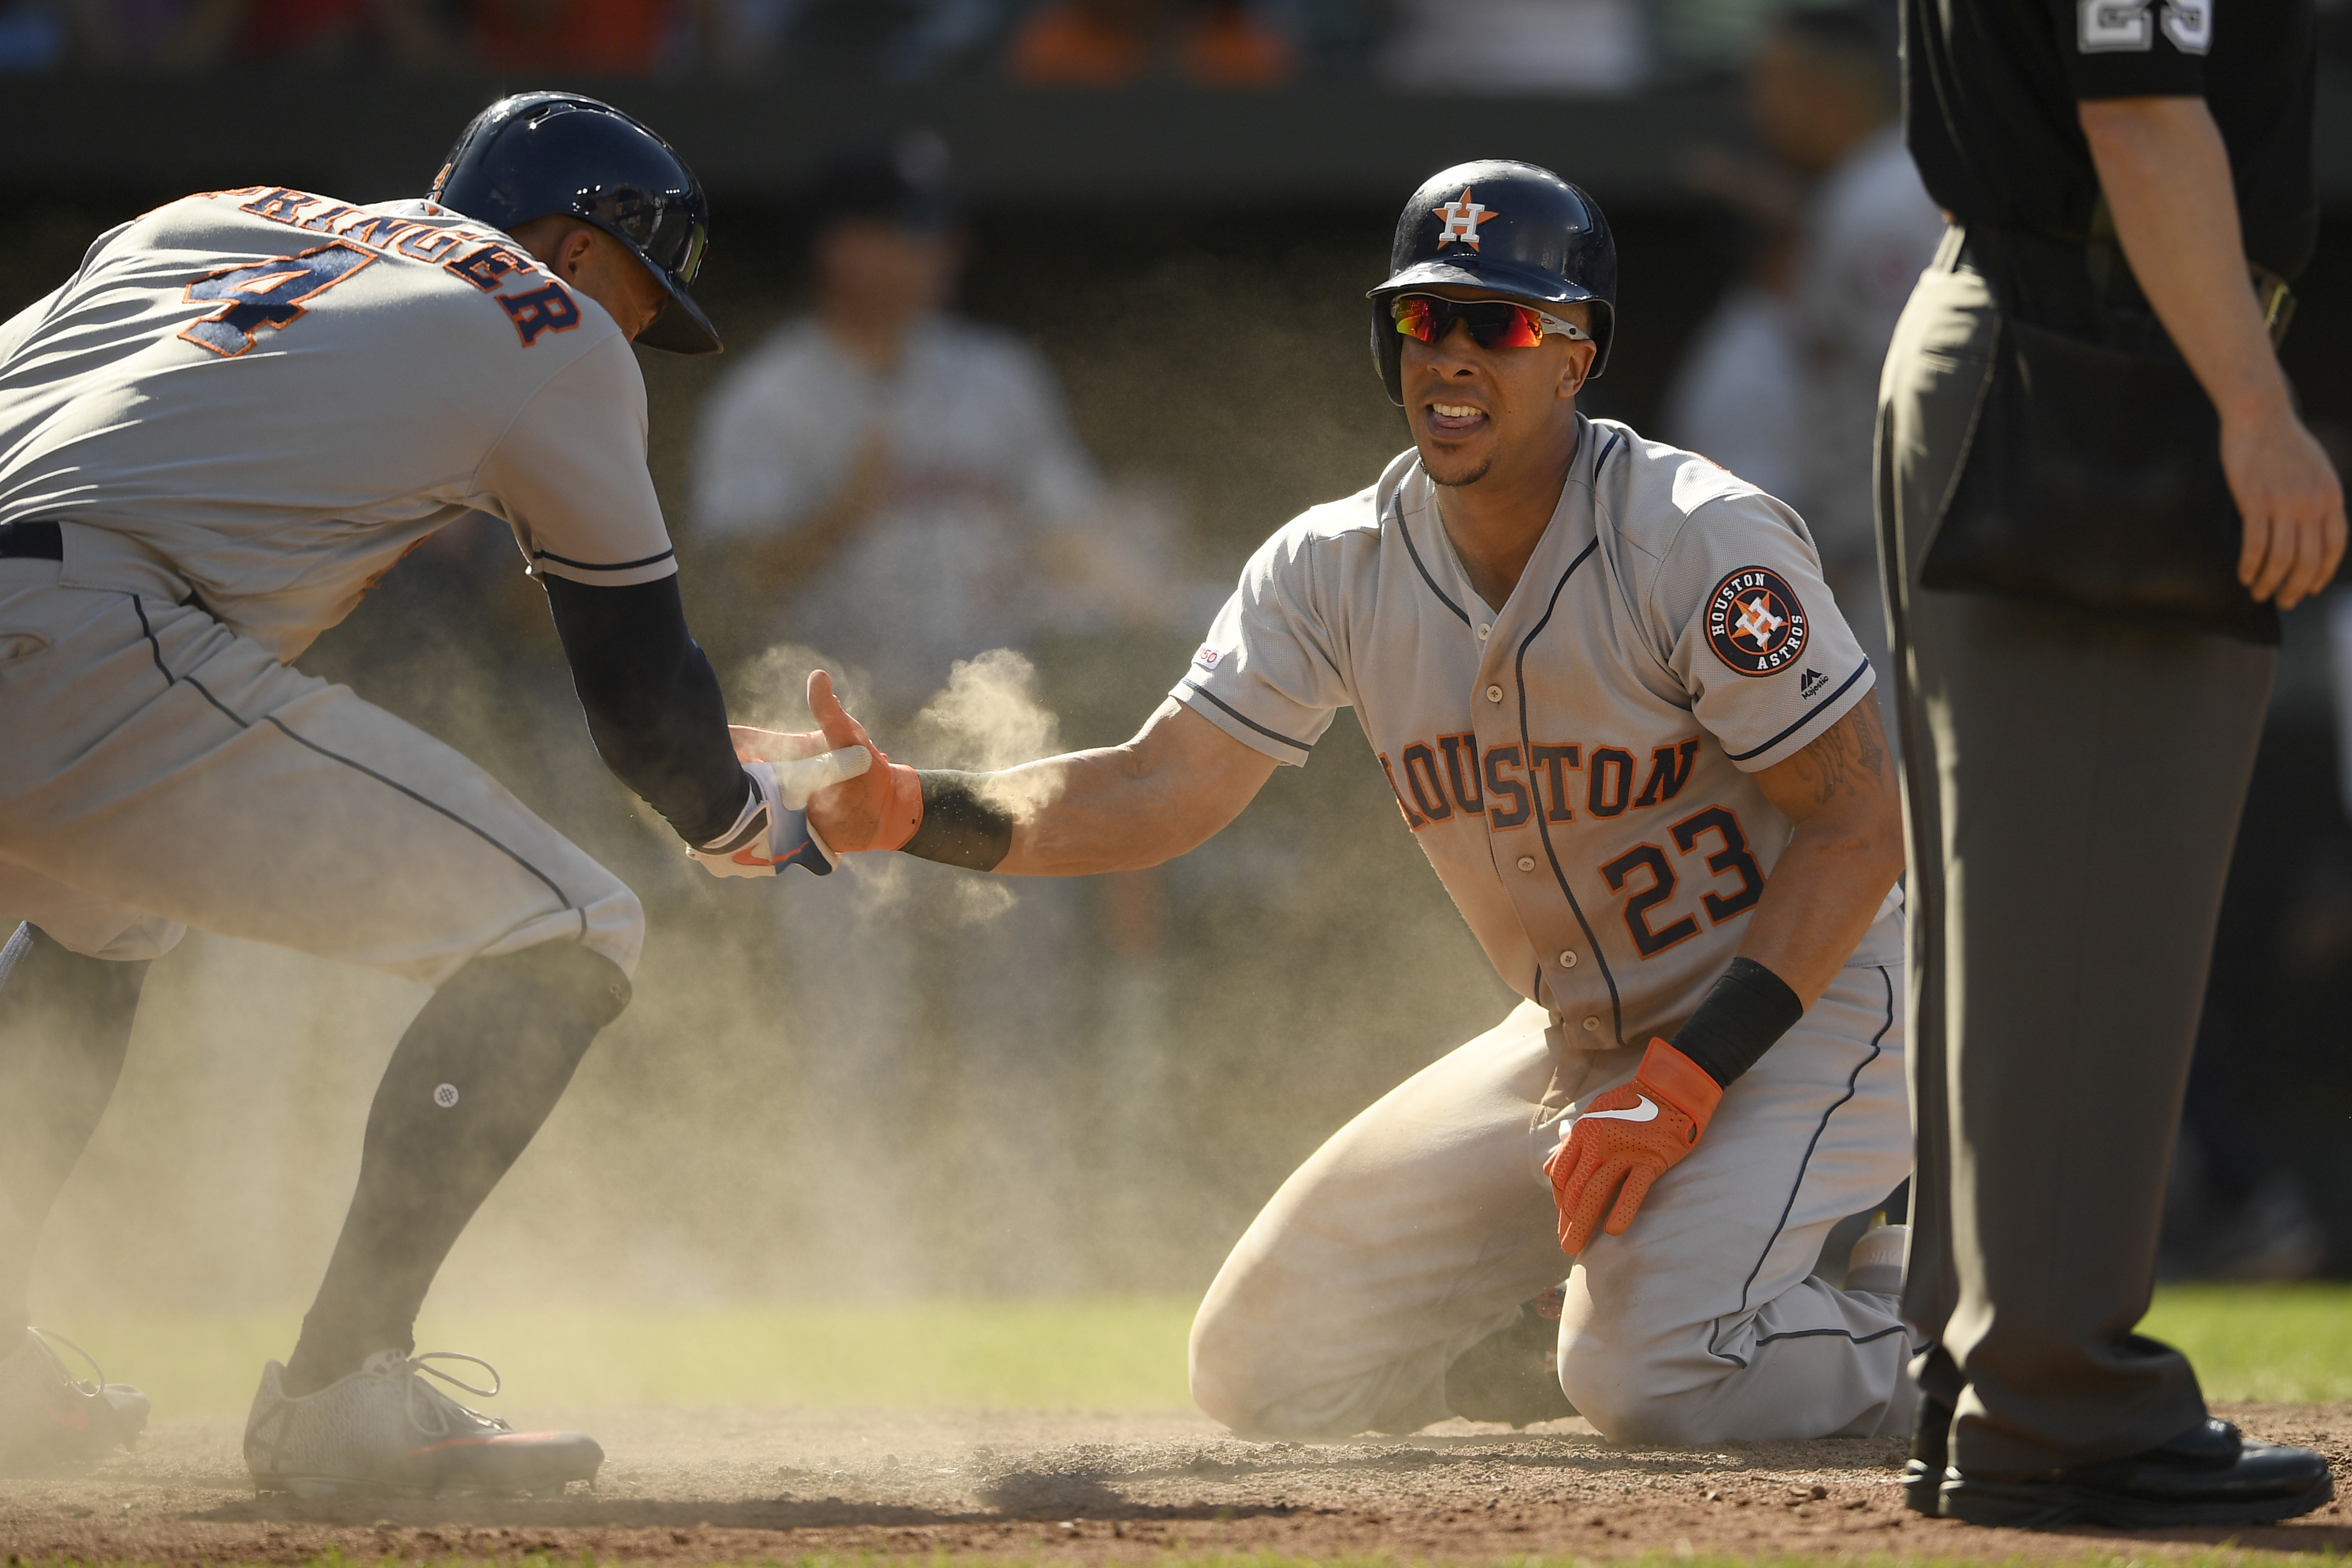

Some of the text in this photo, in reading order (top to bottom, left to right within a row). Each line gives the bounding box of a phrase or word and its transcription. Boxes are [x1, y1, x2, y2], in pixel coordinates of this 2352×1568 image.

[432, 163, 451, 190] 4
[1439, 202, 1485, 243] H
[176, 239, 378, 357] 4
[1712, 573, 1765, 637] HOUSTON
[1757, 615, 1802, 670] ASTROS
[1801, 676, 1829, 700] Majestic
[1598, 804, 1766, 960] 23
